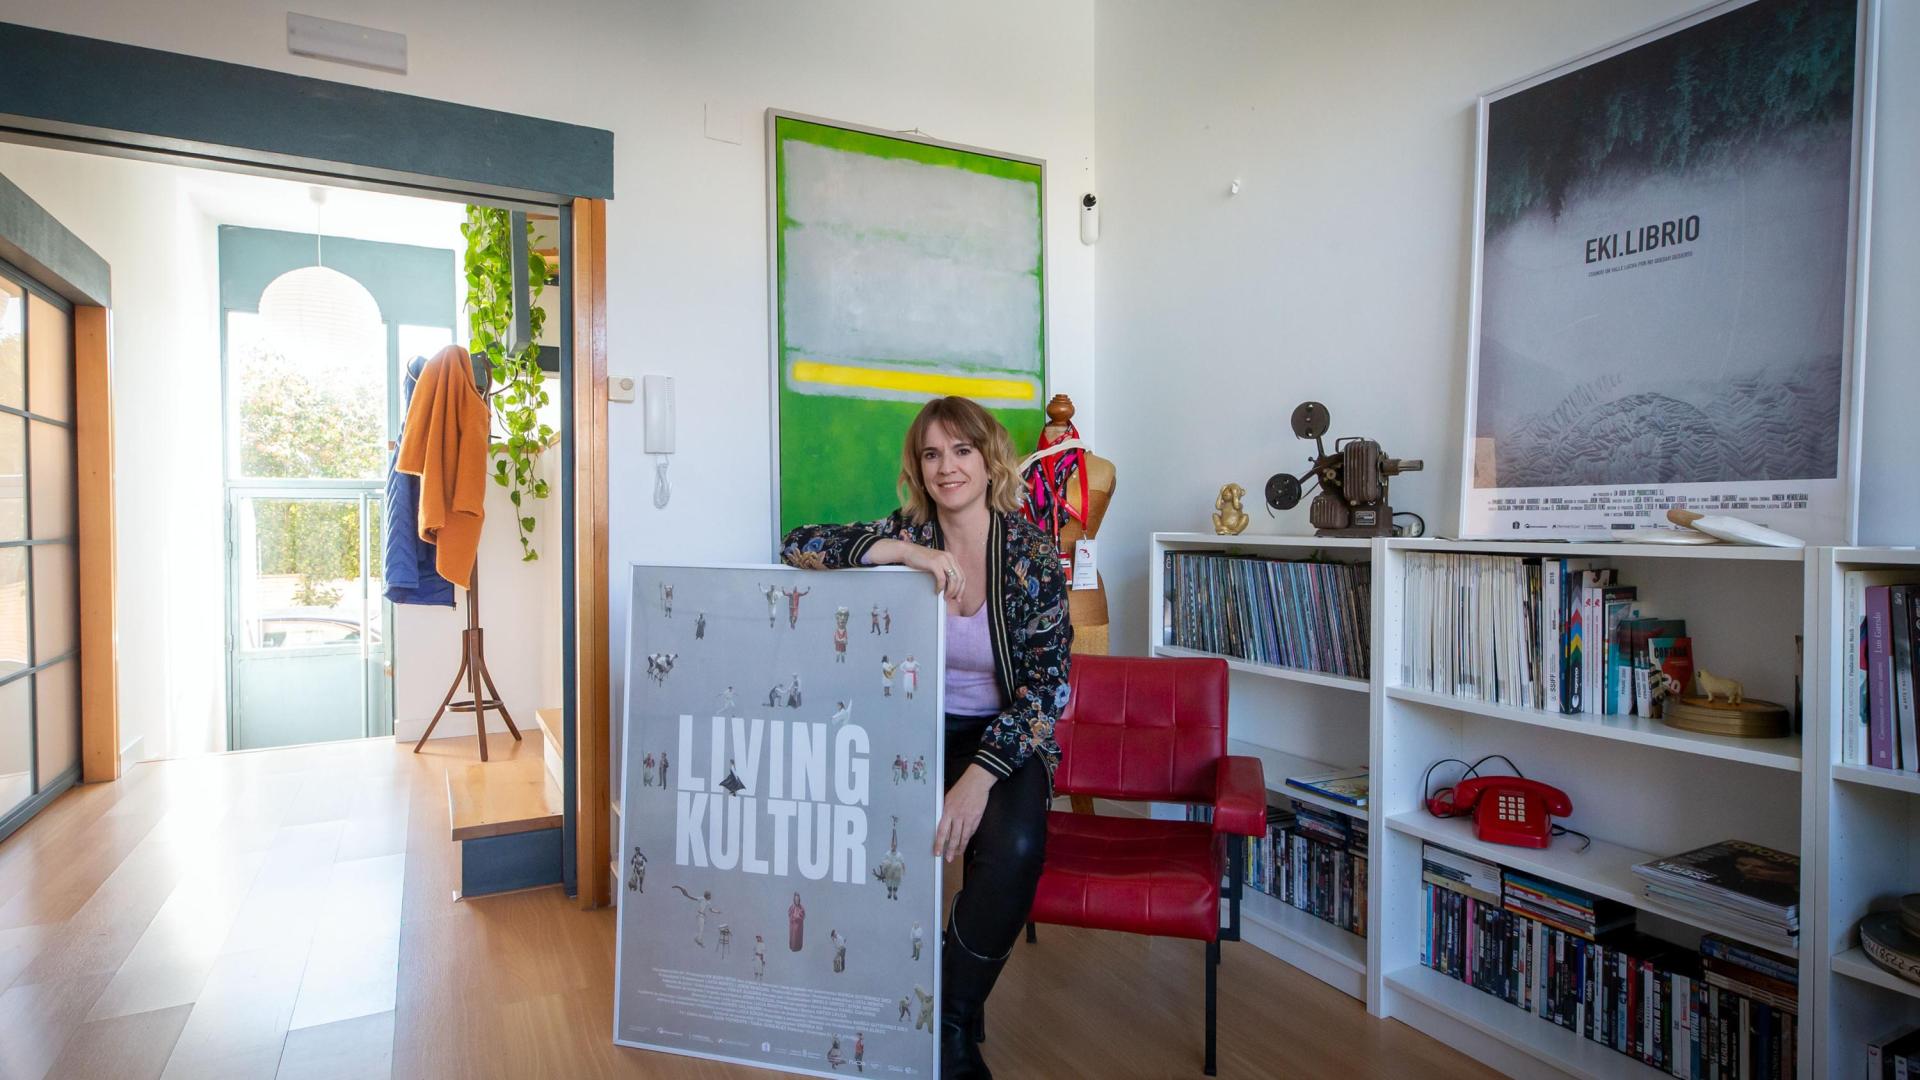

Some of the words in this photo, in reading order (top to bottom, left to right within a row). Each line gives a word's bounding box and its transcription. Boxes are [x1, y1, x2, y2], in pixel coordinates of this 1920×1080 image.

[1585, 215, 1700, 264] EKI.LIBRIO
[1872, 611, 1882, 638] Garrido
[1873, 639, 1883, 653] Luis
[1549, 674, 1557, 692] SSIFF
[678, 714, 870, 806] LIVING
[676, 791, 868, 885] KULTUR
